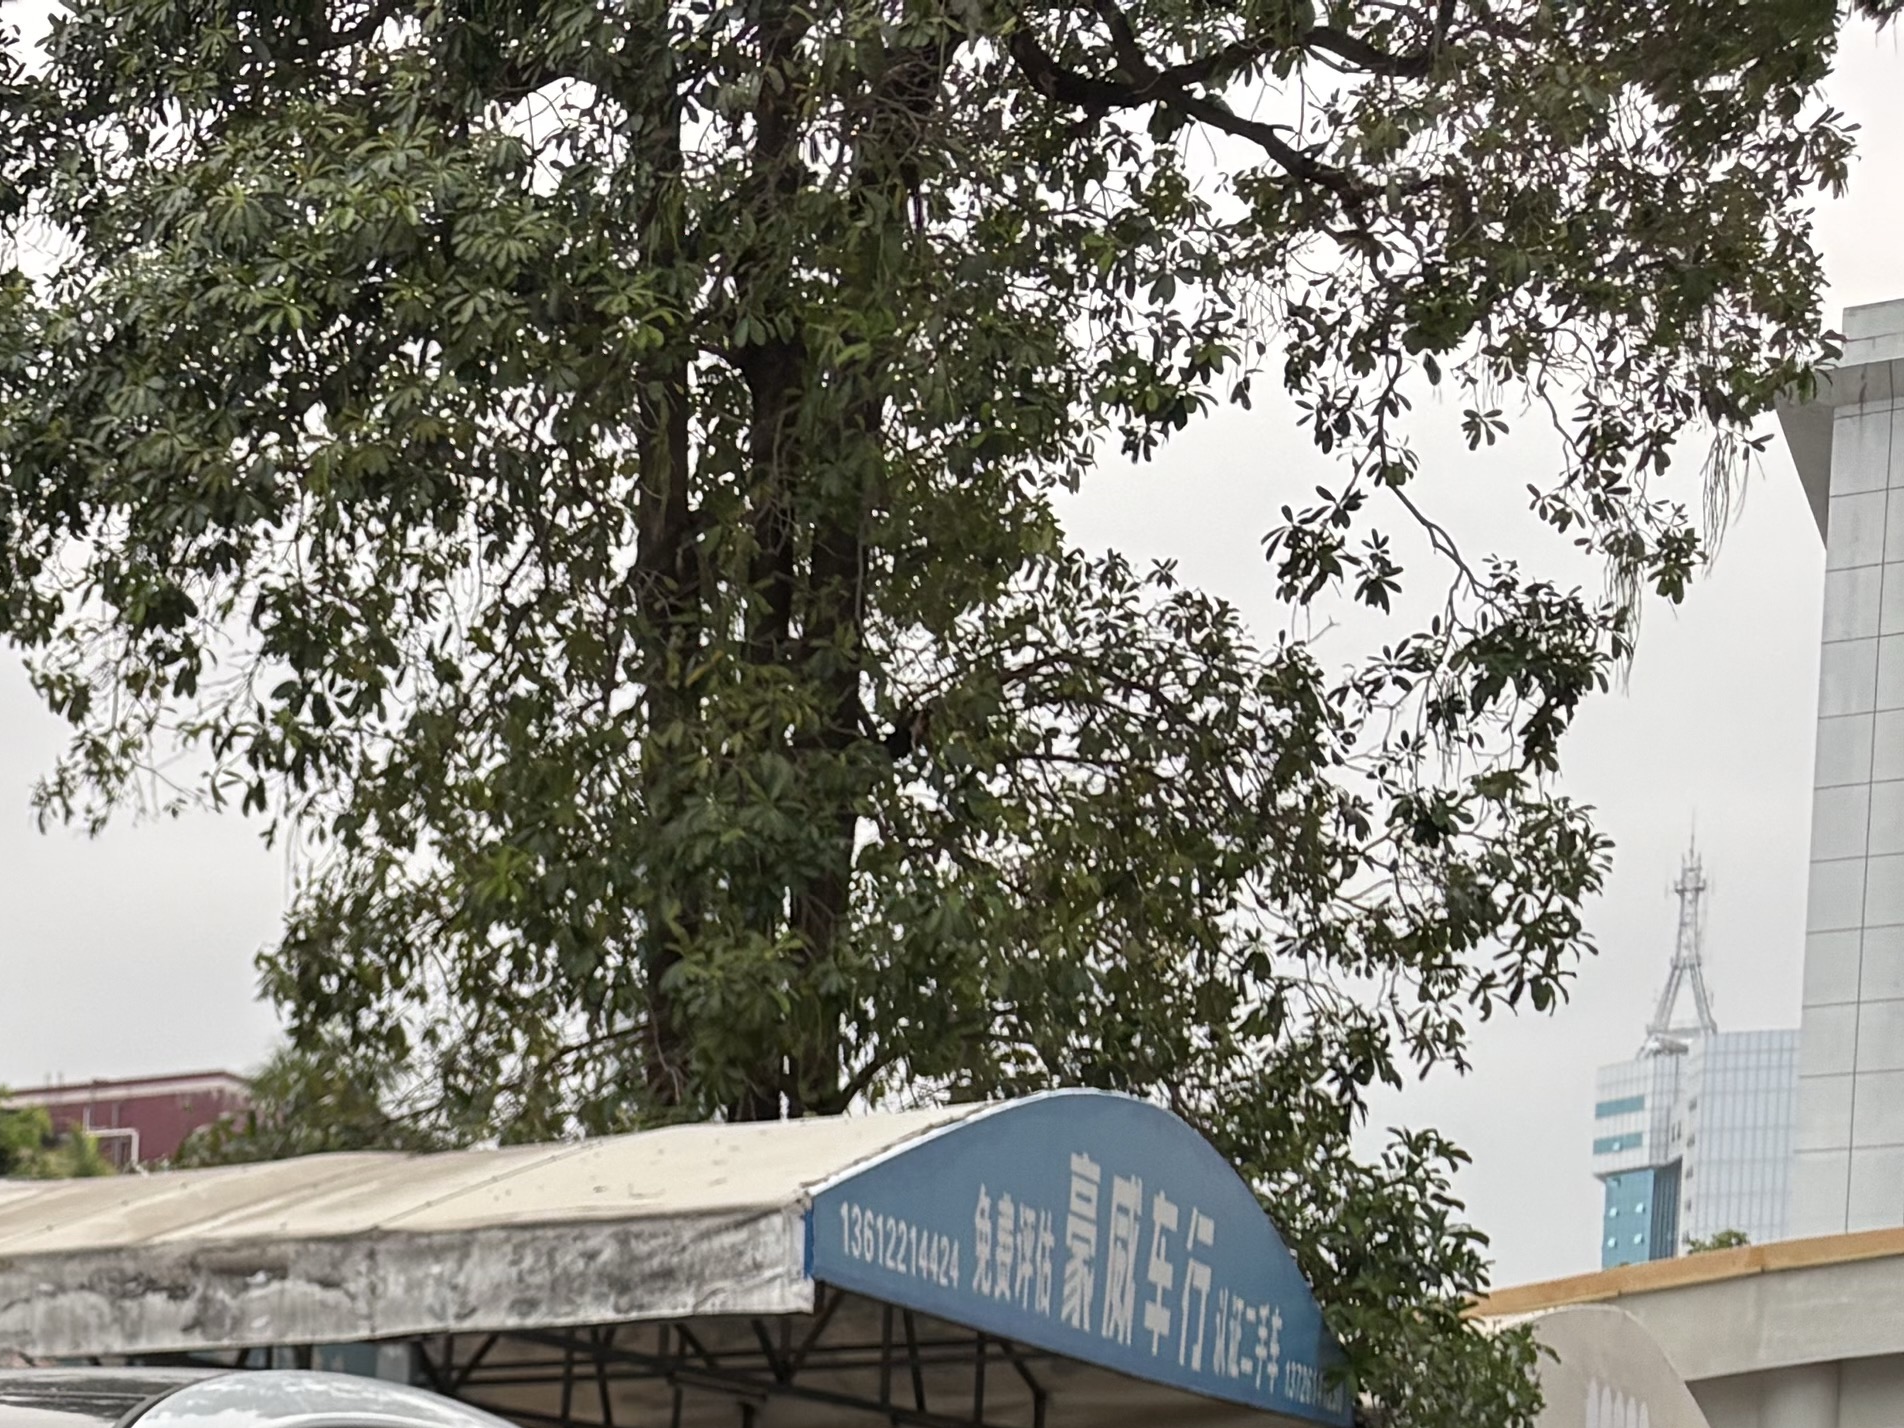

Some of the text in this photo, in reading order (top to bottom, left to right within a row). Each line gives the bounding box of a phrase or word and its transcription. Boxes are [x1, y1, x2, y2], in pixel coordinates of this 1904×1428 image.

[839, 1200, 960, 1288] 13612214424
[971, 1181, 1055, 1318] 免费评估
[1061, 1151, 1215, 1373] 豪威车行
